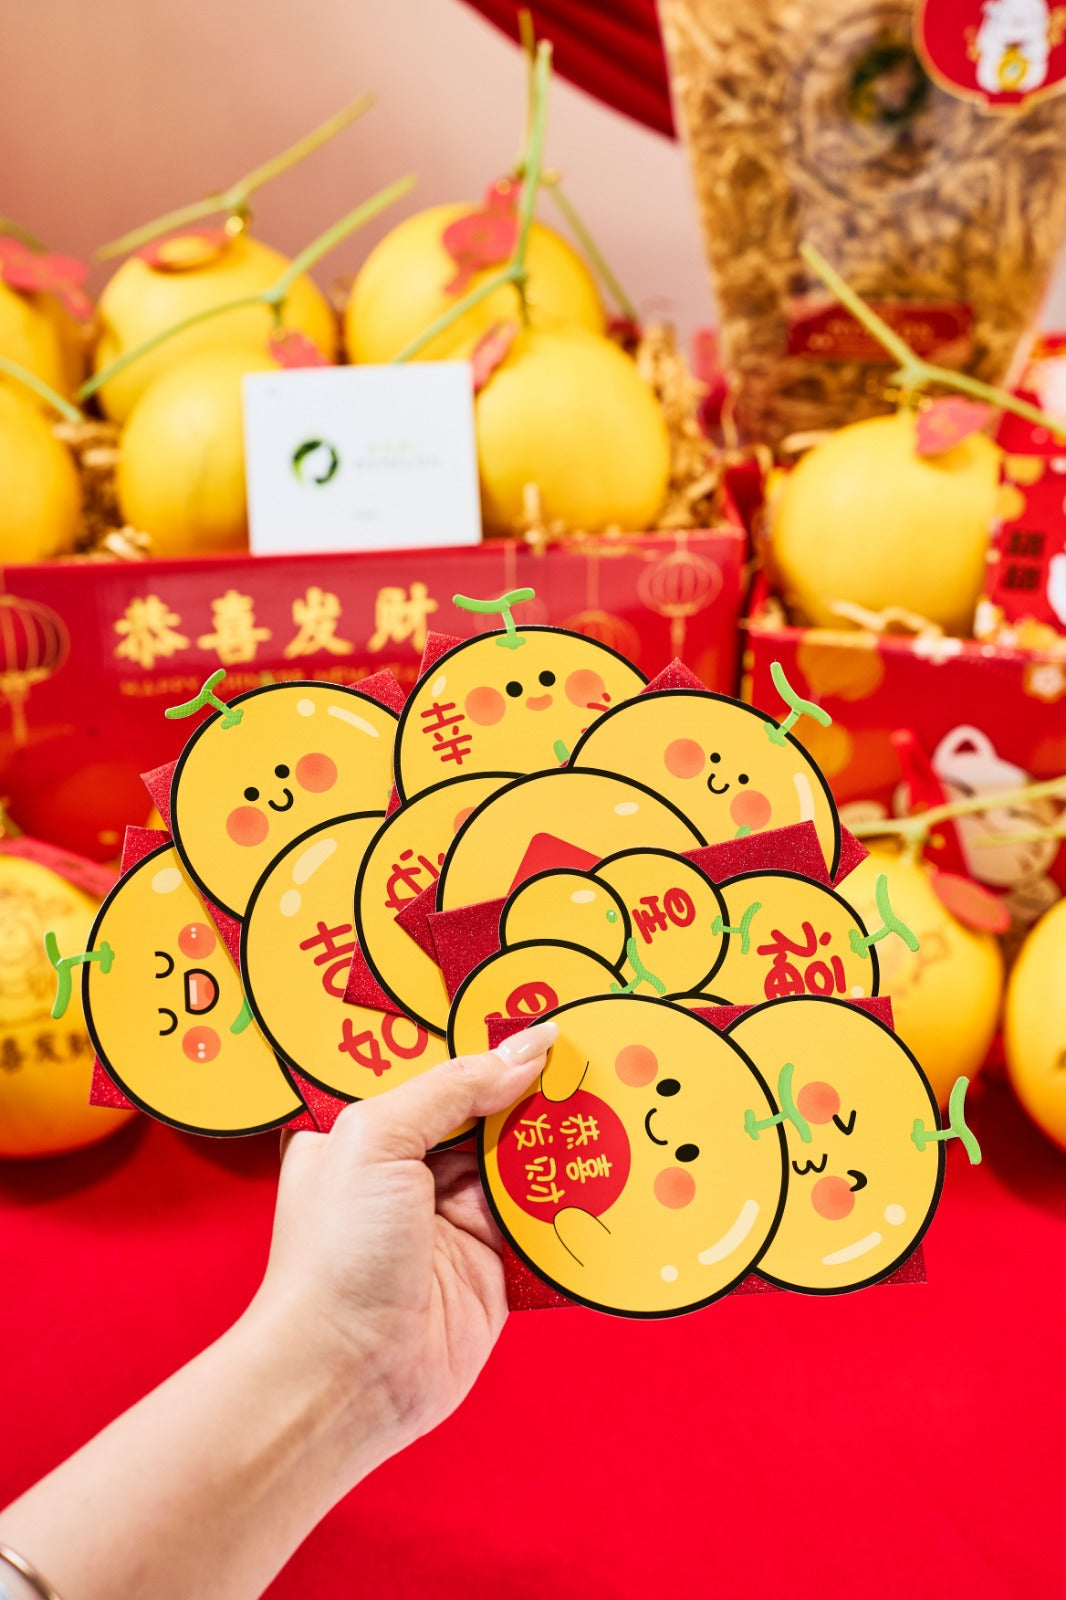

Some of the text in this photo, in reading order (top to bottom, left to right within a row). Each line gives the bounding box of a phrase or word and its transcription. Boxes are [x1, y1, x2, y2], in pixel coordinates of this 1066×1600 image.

[114, 581, 439, 668] 恭喜发财
[420, 702, 473, 765] 幸
